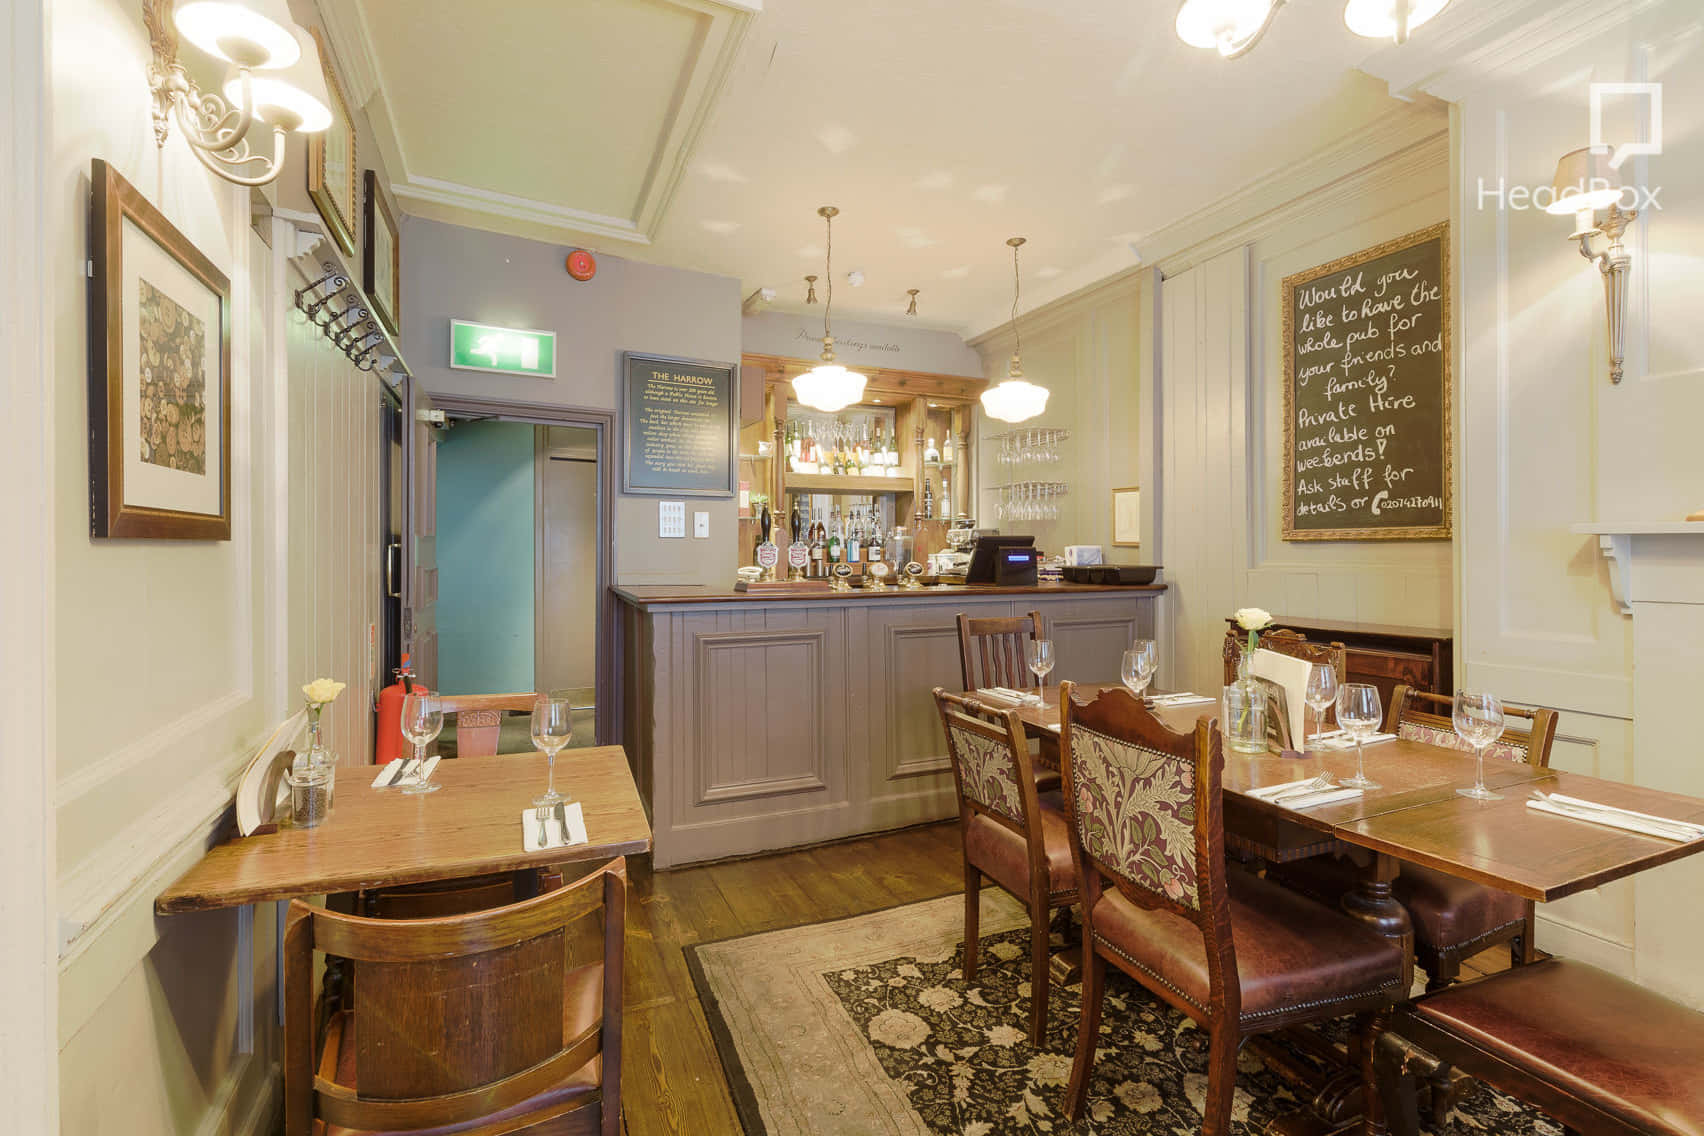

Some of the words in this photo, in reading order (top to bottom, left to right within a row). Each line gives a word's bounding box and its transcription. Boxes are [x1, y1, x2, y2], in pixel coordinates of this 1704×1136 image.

[1300, 271, 1366, 309] Would
[1374, 268, 1418, 297] you
[1300, 310, 1335, 334] like
[1342, 304, 1358, 323] to
[1361, 298, 1405, 318] have
[1410, 280, 1441, 305] the
[1298, 331, 1343, 355] whole
[1347, 320, 1379, 351] pub
[1388, 313, 1422, 341] for
[1299, 362, 1334, 387] your
[1341, 342, 1407, 377] friends
[1411, 332, 1442, 356] and
[652, 371, 670, 381] THE
[673, 374, 713, 385] HARROW
[1323, 364, 1397, 401] family?
[1300, 401, 1357, 428] Private
[1369, 393, 1416, 413] Hire
[1299, 424, 1368, 451] available
[1376, 424, 1396, 438] on
[1297, 439, 1387, 472] weekends!
[1297, 479, 1323, 495] Ask
[1328, 467, 1372, 490] staff
[1383, 464, 1414, 488] for
[1297, 495, 1346, 516] details
[1351, 497, 1369, 508] or
